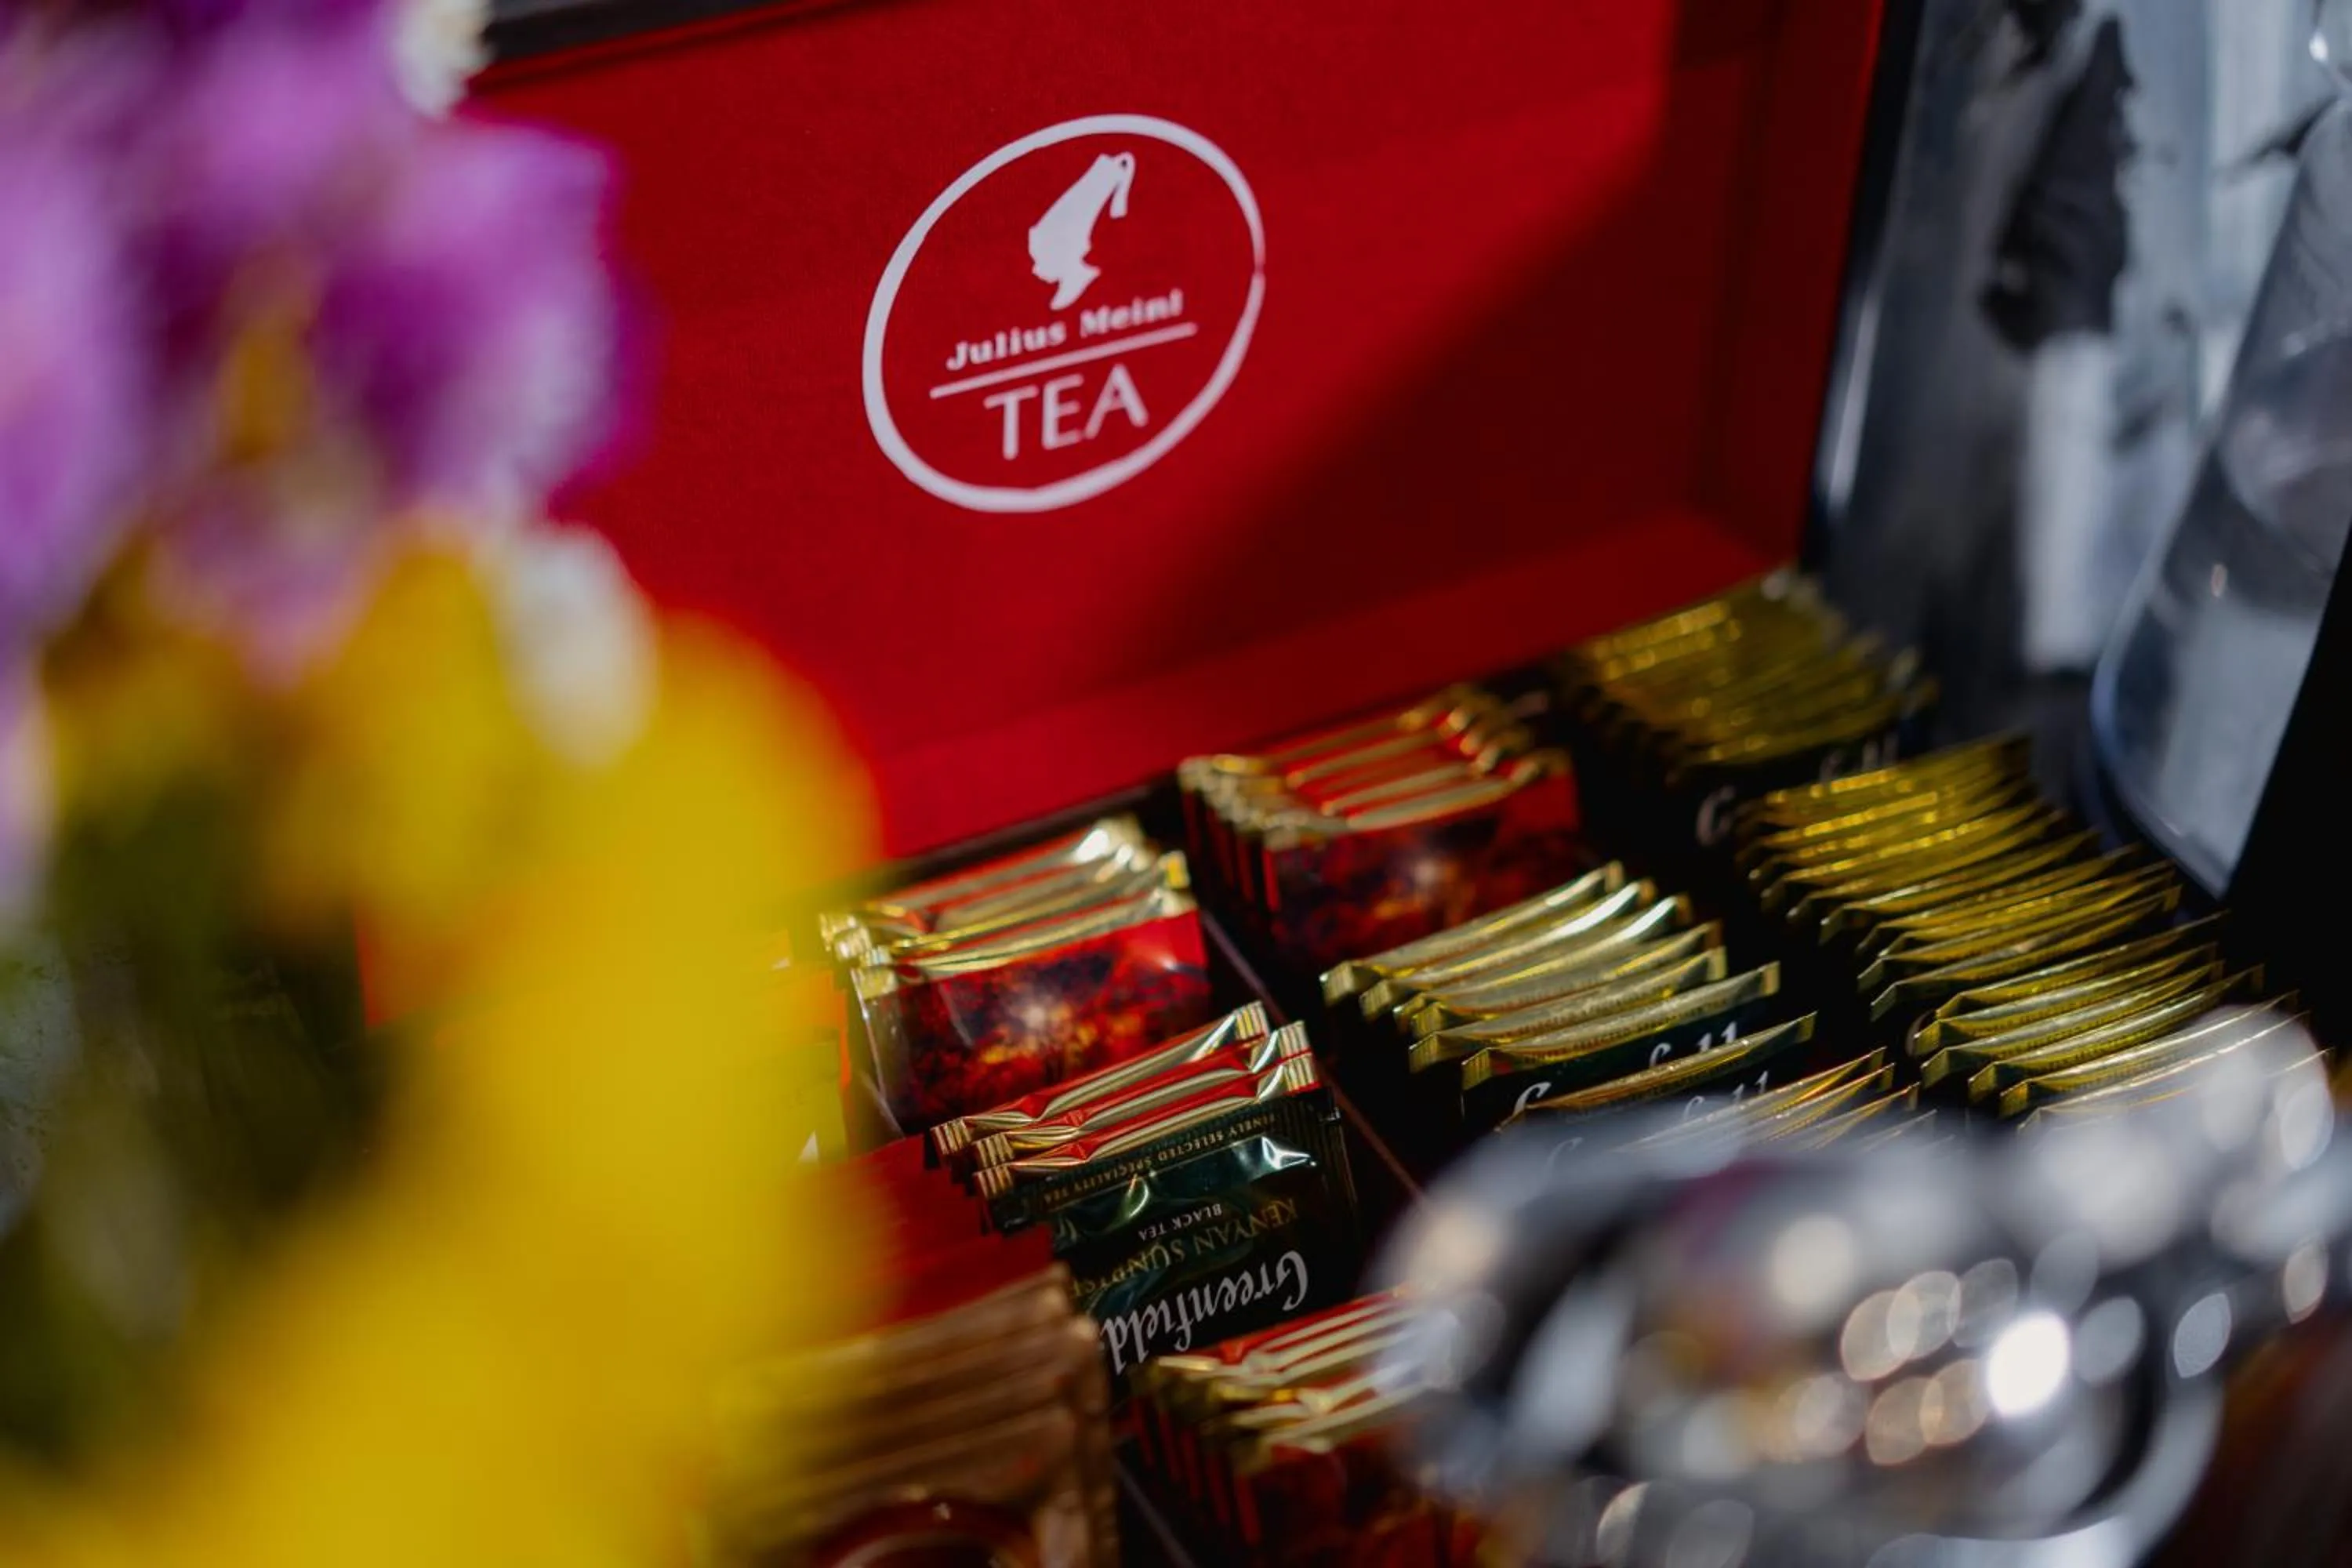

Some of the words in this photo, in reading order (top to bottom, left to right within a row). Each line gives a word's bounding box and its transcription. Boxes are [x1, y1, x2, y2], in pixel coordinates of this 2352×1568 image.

[946, 321, 1067, 371] Julius
[1080, 288, 1183, 337] Meinl
[983, 363, 1149, 459] TEA
[1229, 1112, 1276, 1138] FINELY
[1157, 1133, 1225, 1162] SELECTED
[1044, 1185, 1070, 1203] TEA
[1138, 1221, 1169, 1241] TEA
[1172, 1203, 1223, 1230] BLACK
[1192, 1198, 1299, 1255] KENYAN
[1100, 1250, 1308, 1376] Greenfield
